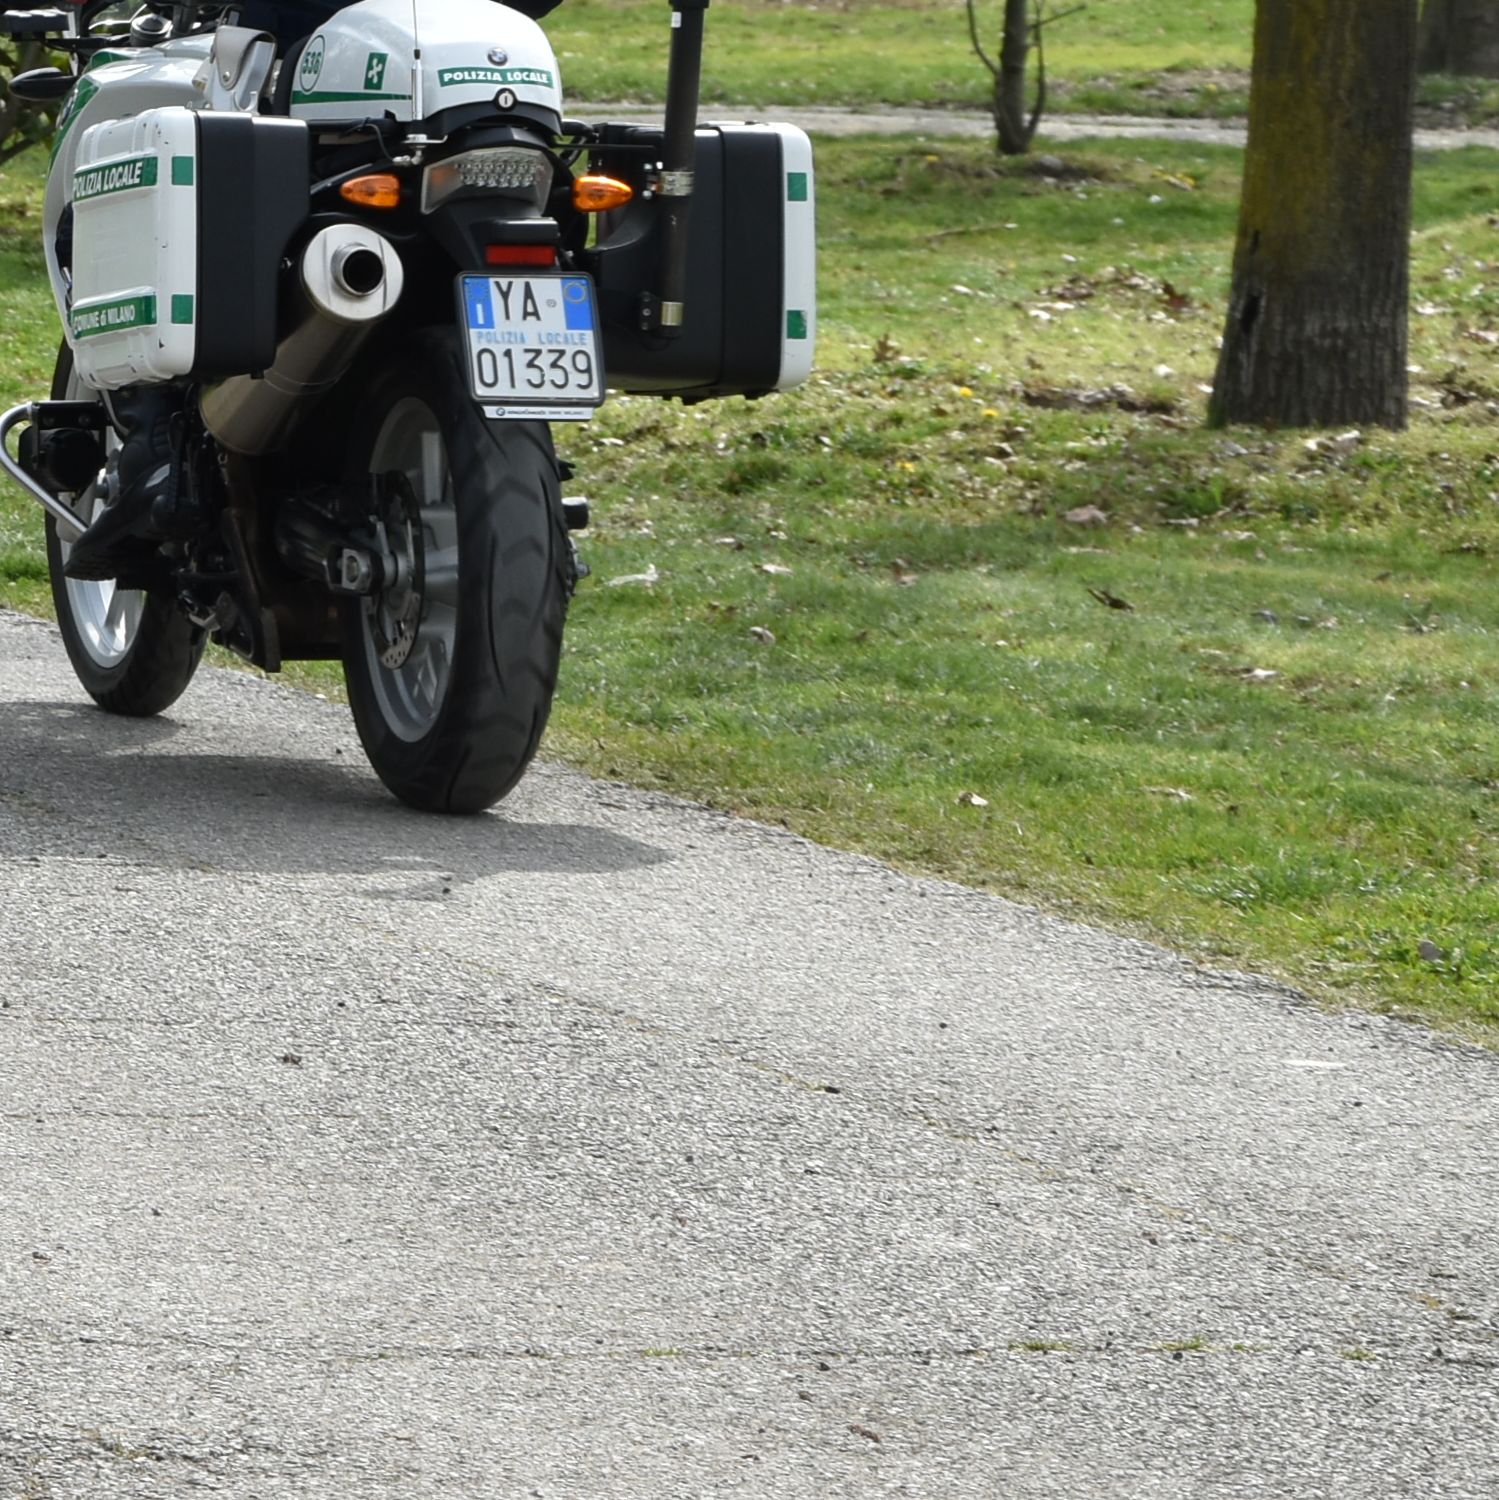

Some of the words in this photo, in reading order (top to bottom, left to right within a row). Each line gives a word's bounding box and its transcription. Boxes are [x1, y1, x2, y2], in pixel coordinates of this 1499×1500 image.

[302, 51, 322, 75] 536
[443, 71, 503, 82] POLIZIA
[506, 71, 549, 84] LOCALE
[103, 162, 143, 191] LOCALE
[494, 280, 541, 321] YA
[74, 311, 99, 334] COMUNE
[107, 305, 135, 324] MILANO
[477, 331, 526, 344] POLIZIA
[538, 332, 587, 345] LOCALE
[476, 347, 593, 389] 01339
